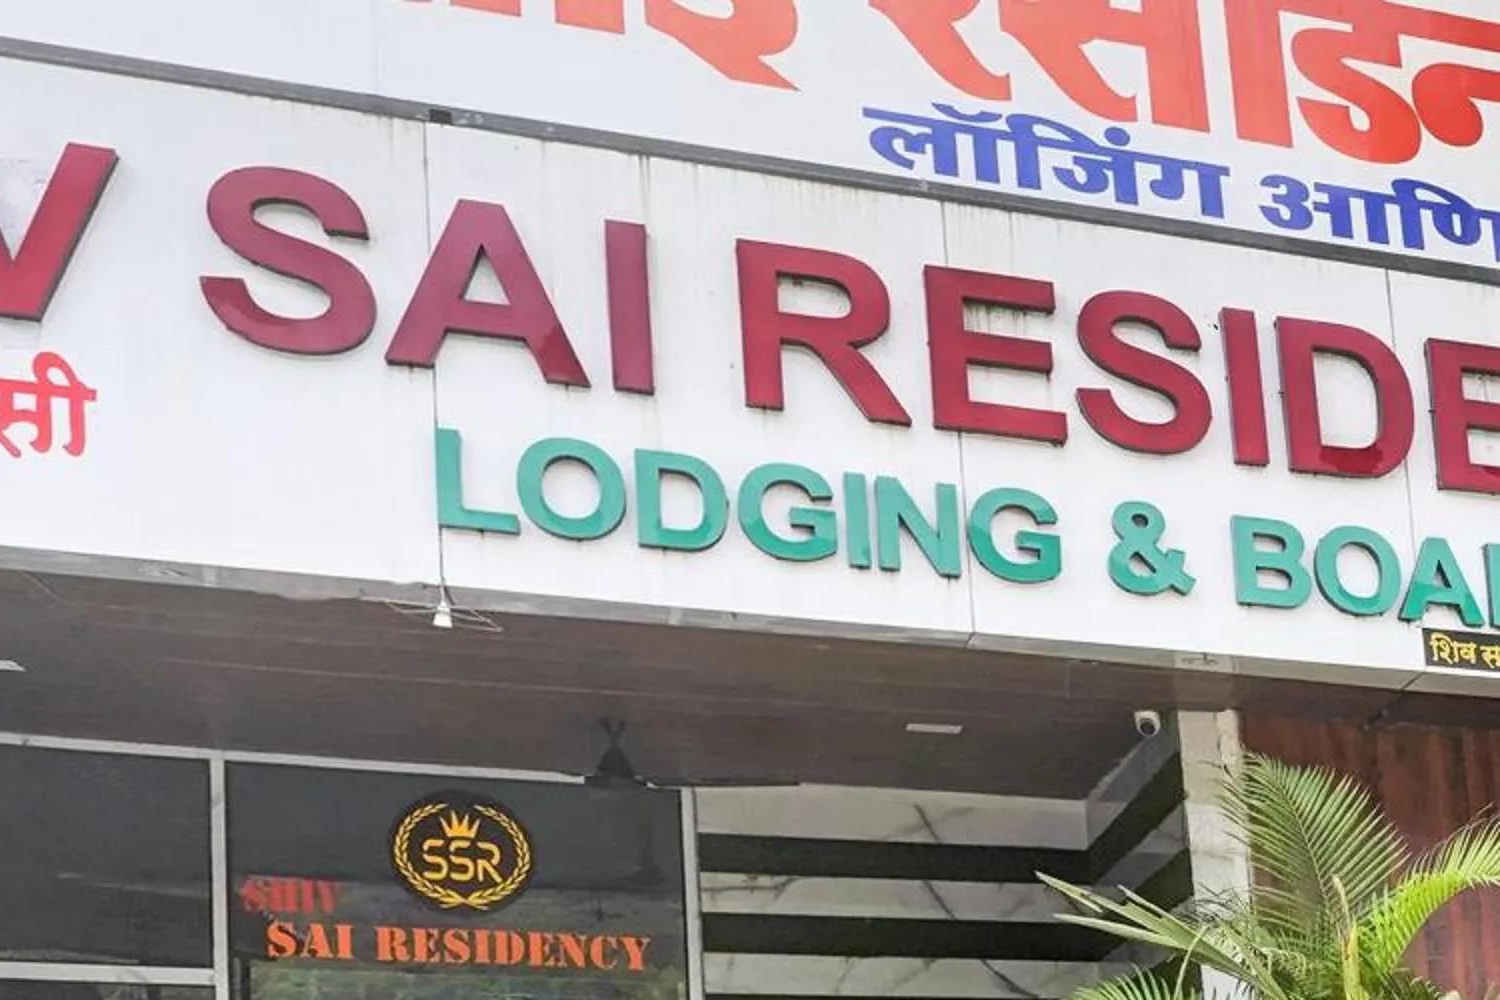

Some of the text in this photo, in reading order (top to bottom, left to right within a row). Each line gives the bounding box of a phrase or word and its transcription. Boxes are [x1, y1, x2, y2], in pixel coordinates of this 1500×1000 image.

[861, 101, 1229, 220] लॉजिंग
[199, 166, 655, 396] SAI
[435, 428, 1500, 629] LODGING & BOA
[1429, 631, 1477, 665] शिव
[421, 838, 503, 883] SSR
[239, 875, 340, 913] SHIV
[267, 921, 651, 972] SAI RESIDENCY
